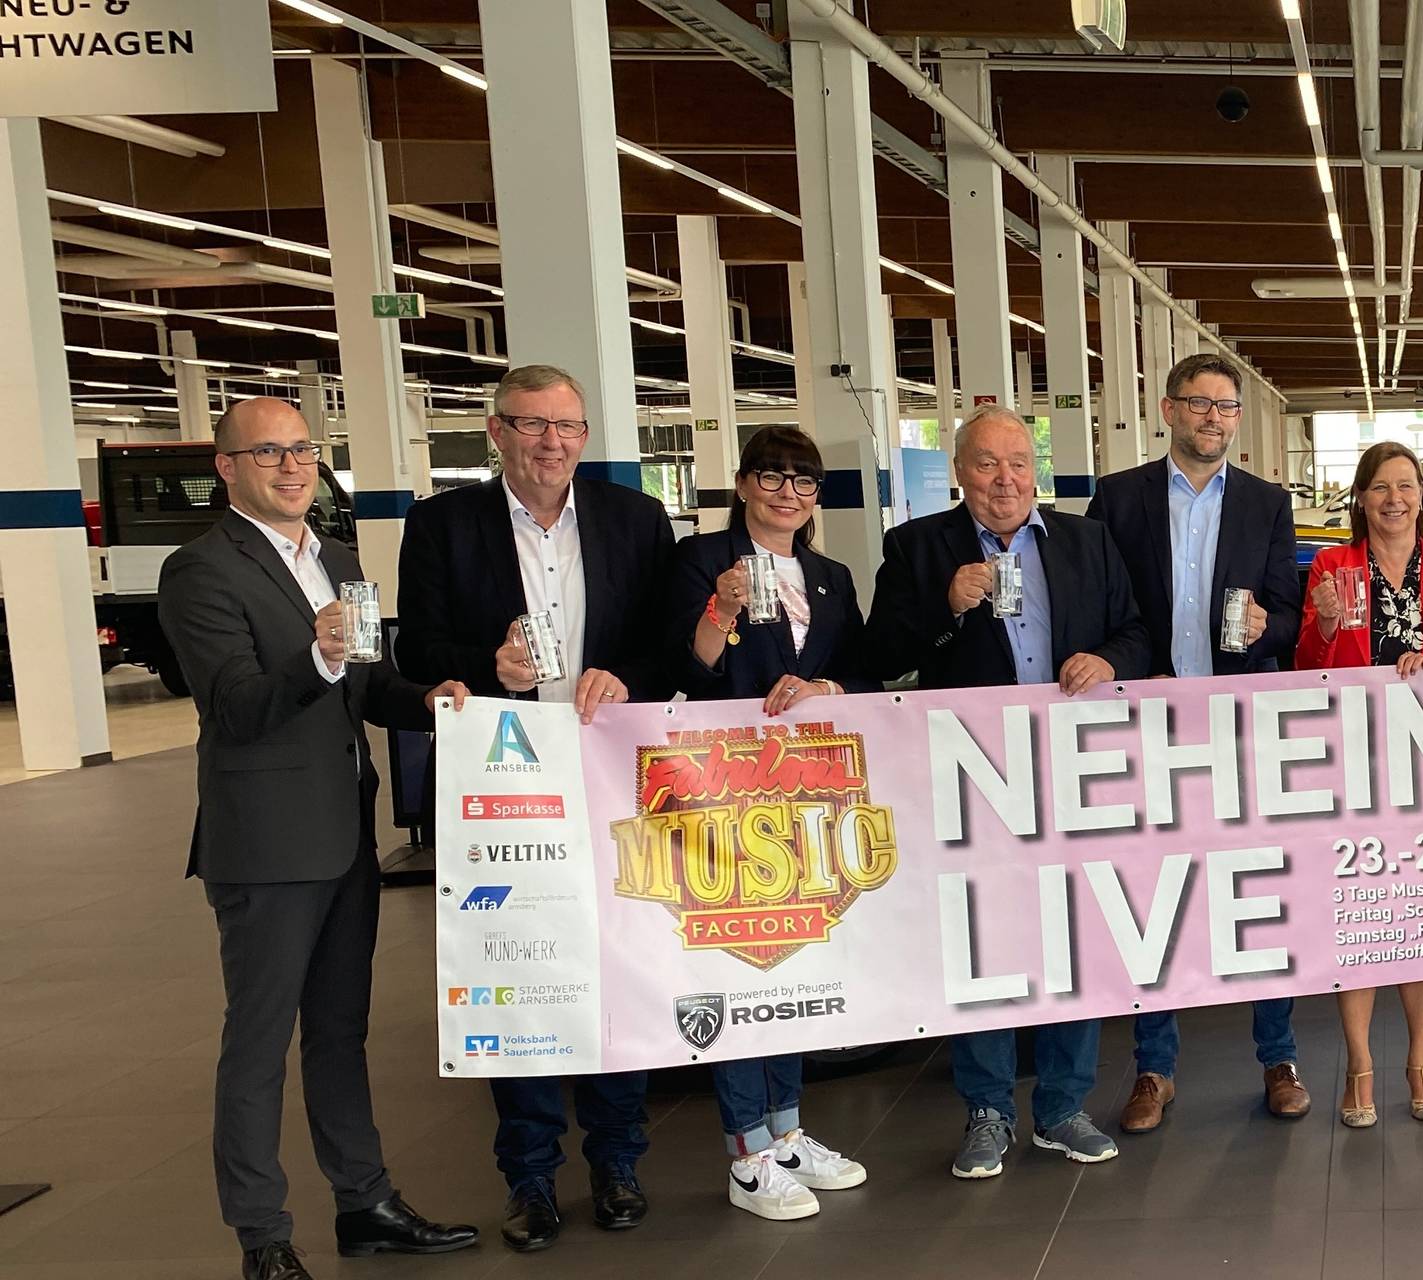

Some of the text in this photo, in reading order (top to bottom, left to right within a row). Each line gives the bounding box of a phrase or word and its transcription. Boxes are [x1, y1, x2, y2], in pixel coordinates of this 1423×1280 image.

[1, 0, 91, 17] NEU-
[666, 721, 834, 745] WELCOME TO THE
[485, 764, 542, 773] ARNSBERG
[643, 736, 866, 812] Fabulous
[492, 802, 562, 818] Sparkasse
[487, 843, 567, 862] VELTINS
[610, 802, 898, 904] MUSIC
[466, 897, 497, 911] wfa
[1333, 888, 1344, 902] 3
[1348, 886, 1387, 904] Tage
[1334, 906, 1393, 924] Freitag
[692, 915, 814, 938] FACTORY
[938, 846, 1289, 1005] LIVE
[1335, 926, 1405, 945] Samstag
[519, 984, 590, 995] STADTWERKE
[729, 981, 843, 1003] powered by Peugeot
[518, 995, 578, 1005] ARNSBERG
[731, 996, 846, 1025] ROSIER
[504, 1034, 557, 1045] Volksbank
[504, 1047, 573, 1057] Sauerland eG
